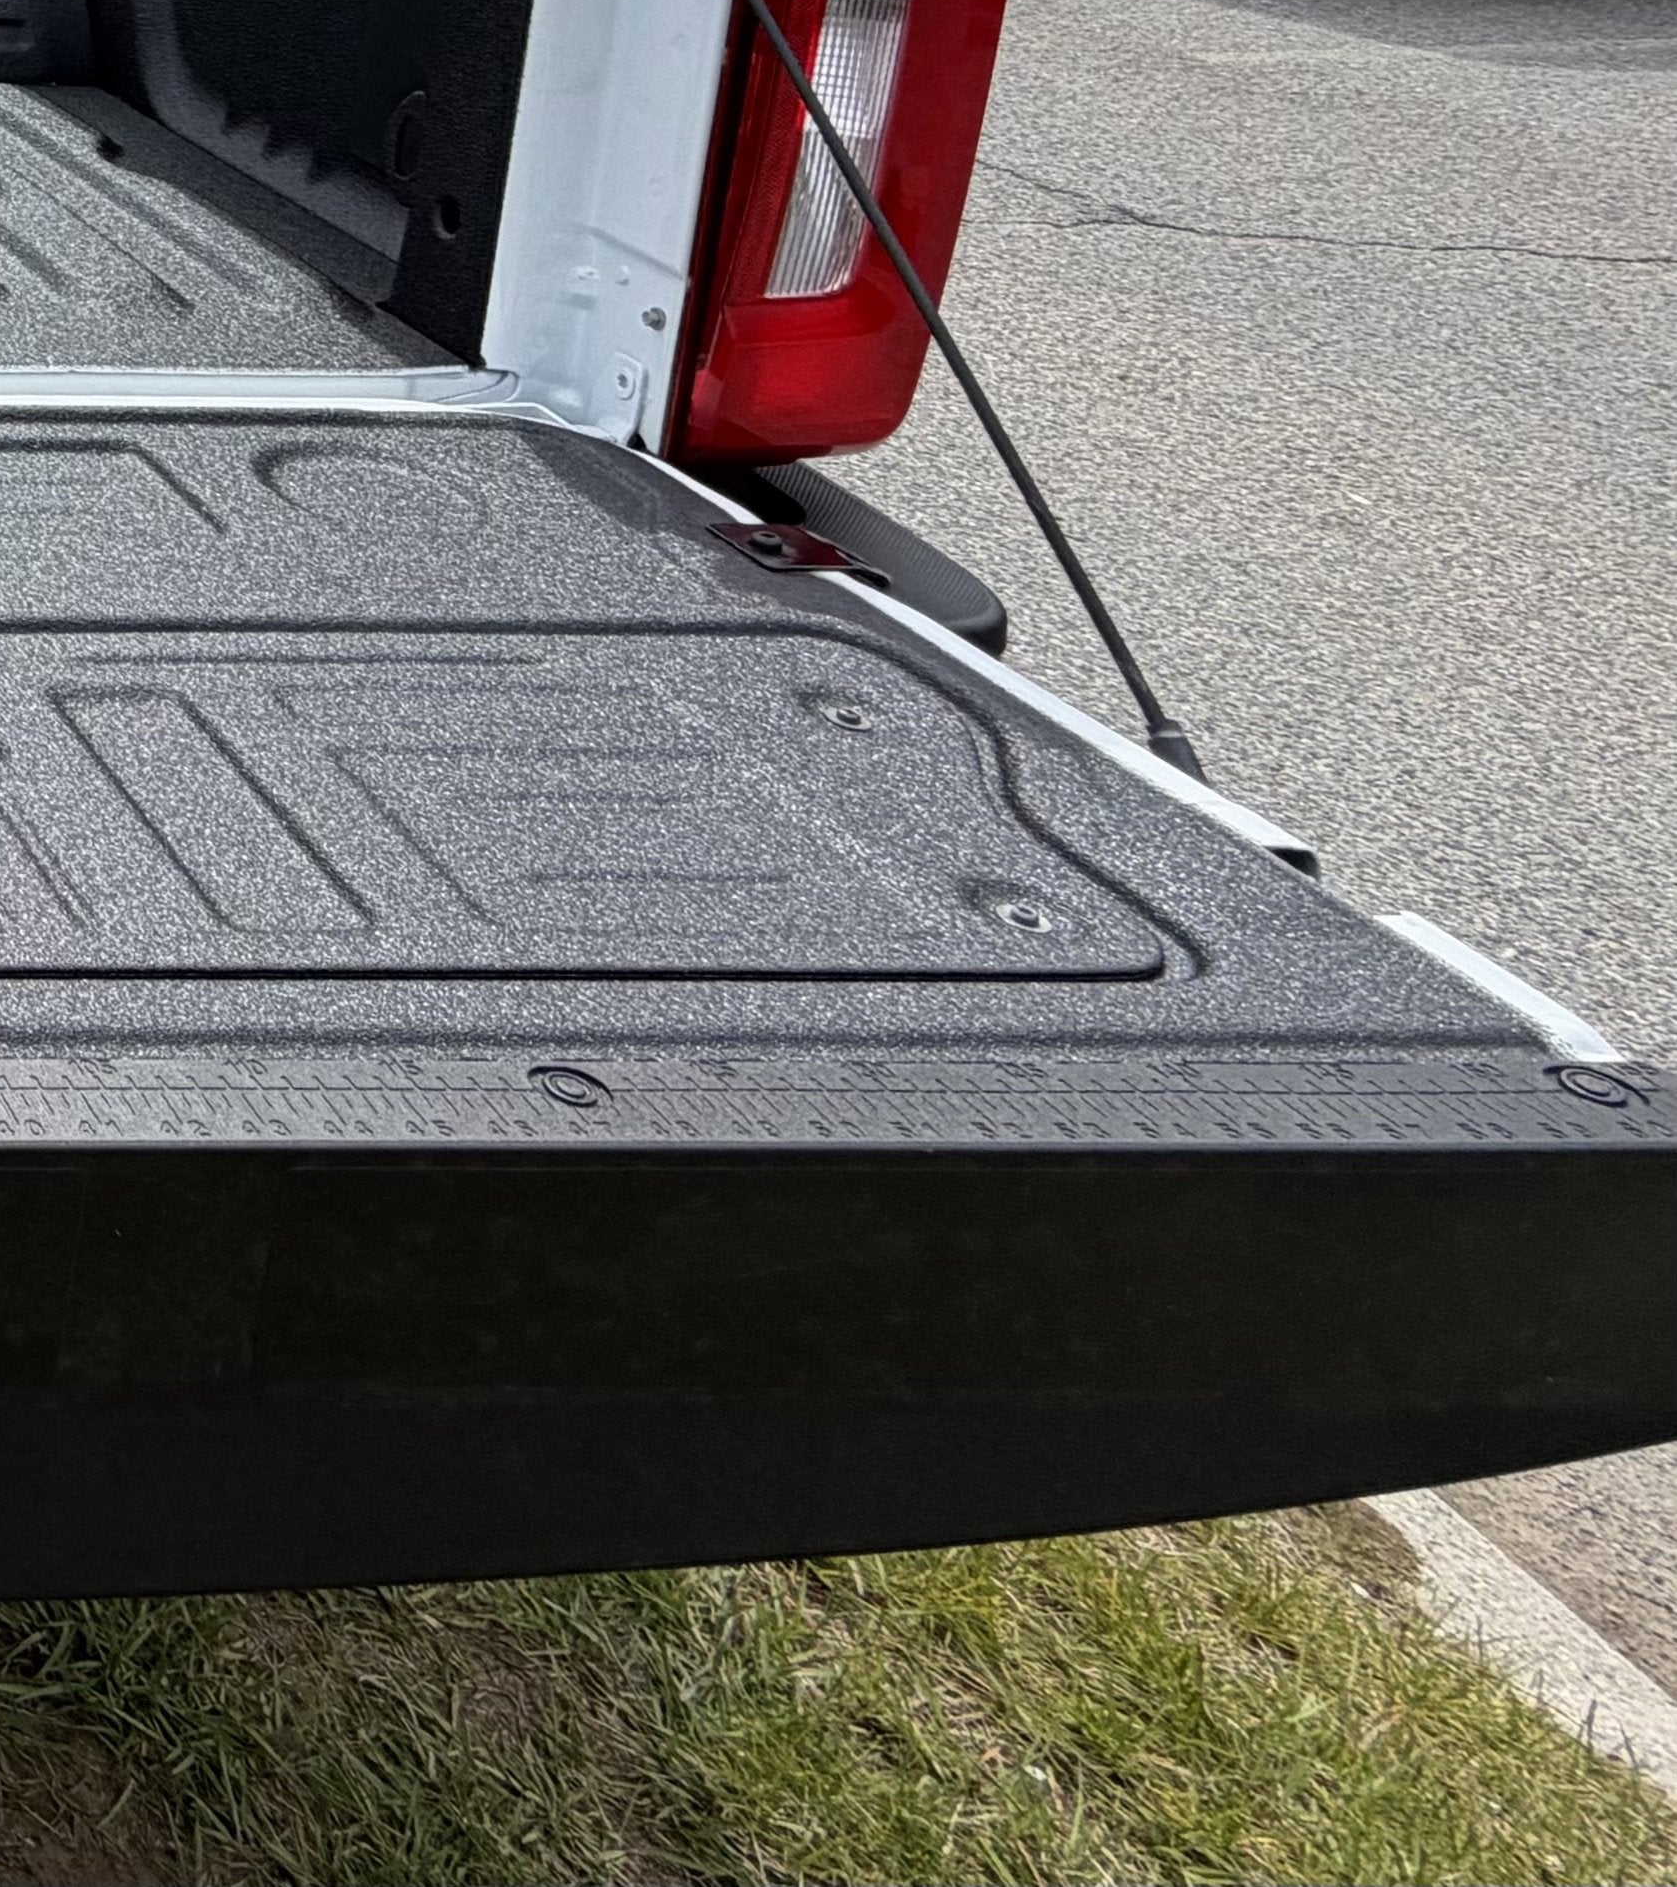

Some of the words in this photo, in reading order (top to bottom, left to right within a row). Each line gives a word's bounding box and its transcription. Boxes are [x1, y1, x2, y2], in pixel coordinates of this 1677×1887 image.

[78, 1119, 123, 1136] 41
[160, 1119, 211, 1136] 42
[242, 1119, 292, 1137] 43
[323, 1120, 374, 1137] 44
[407, 1120, 455, 1137] 45
